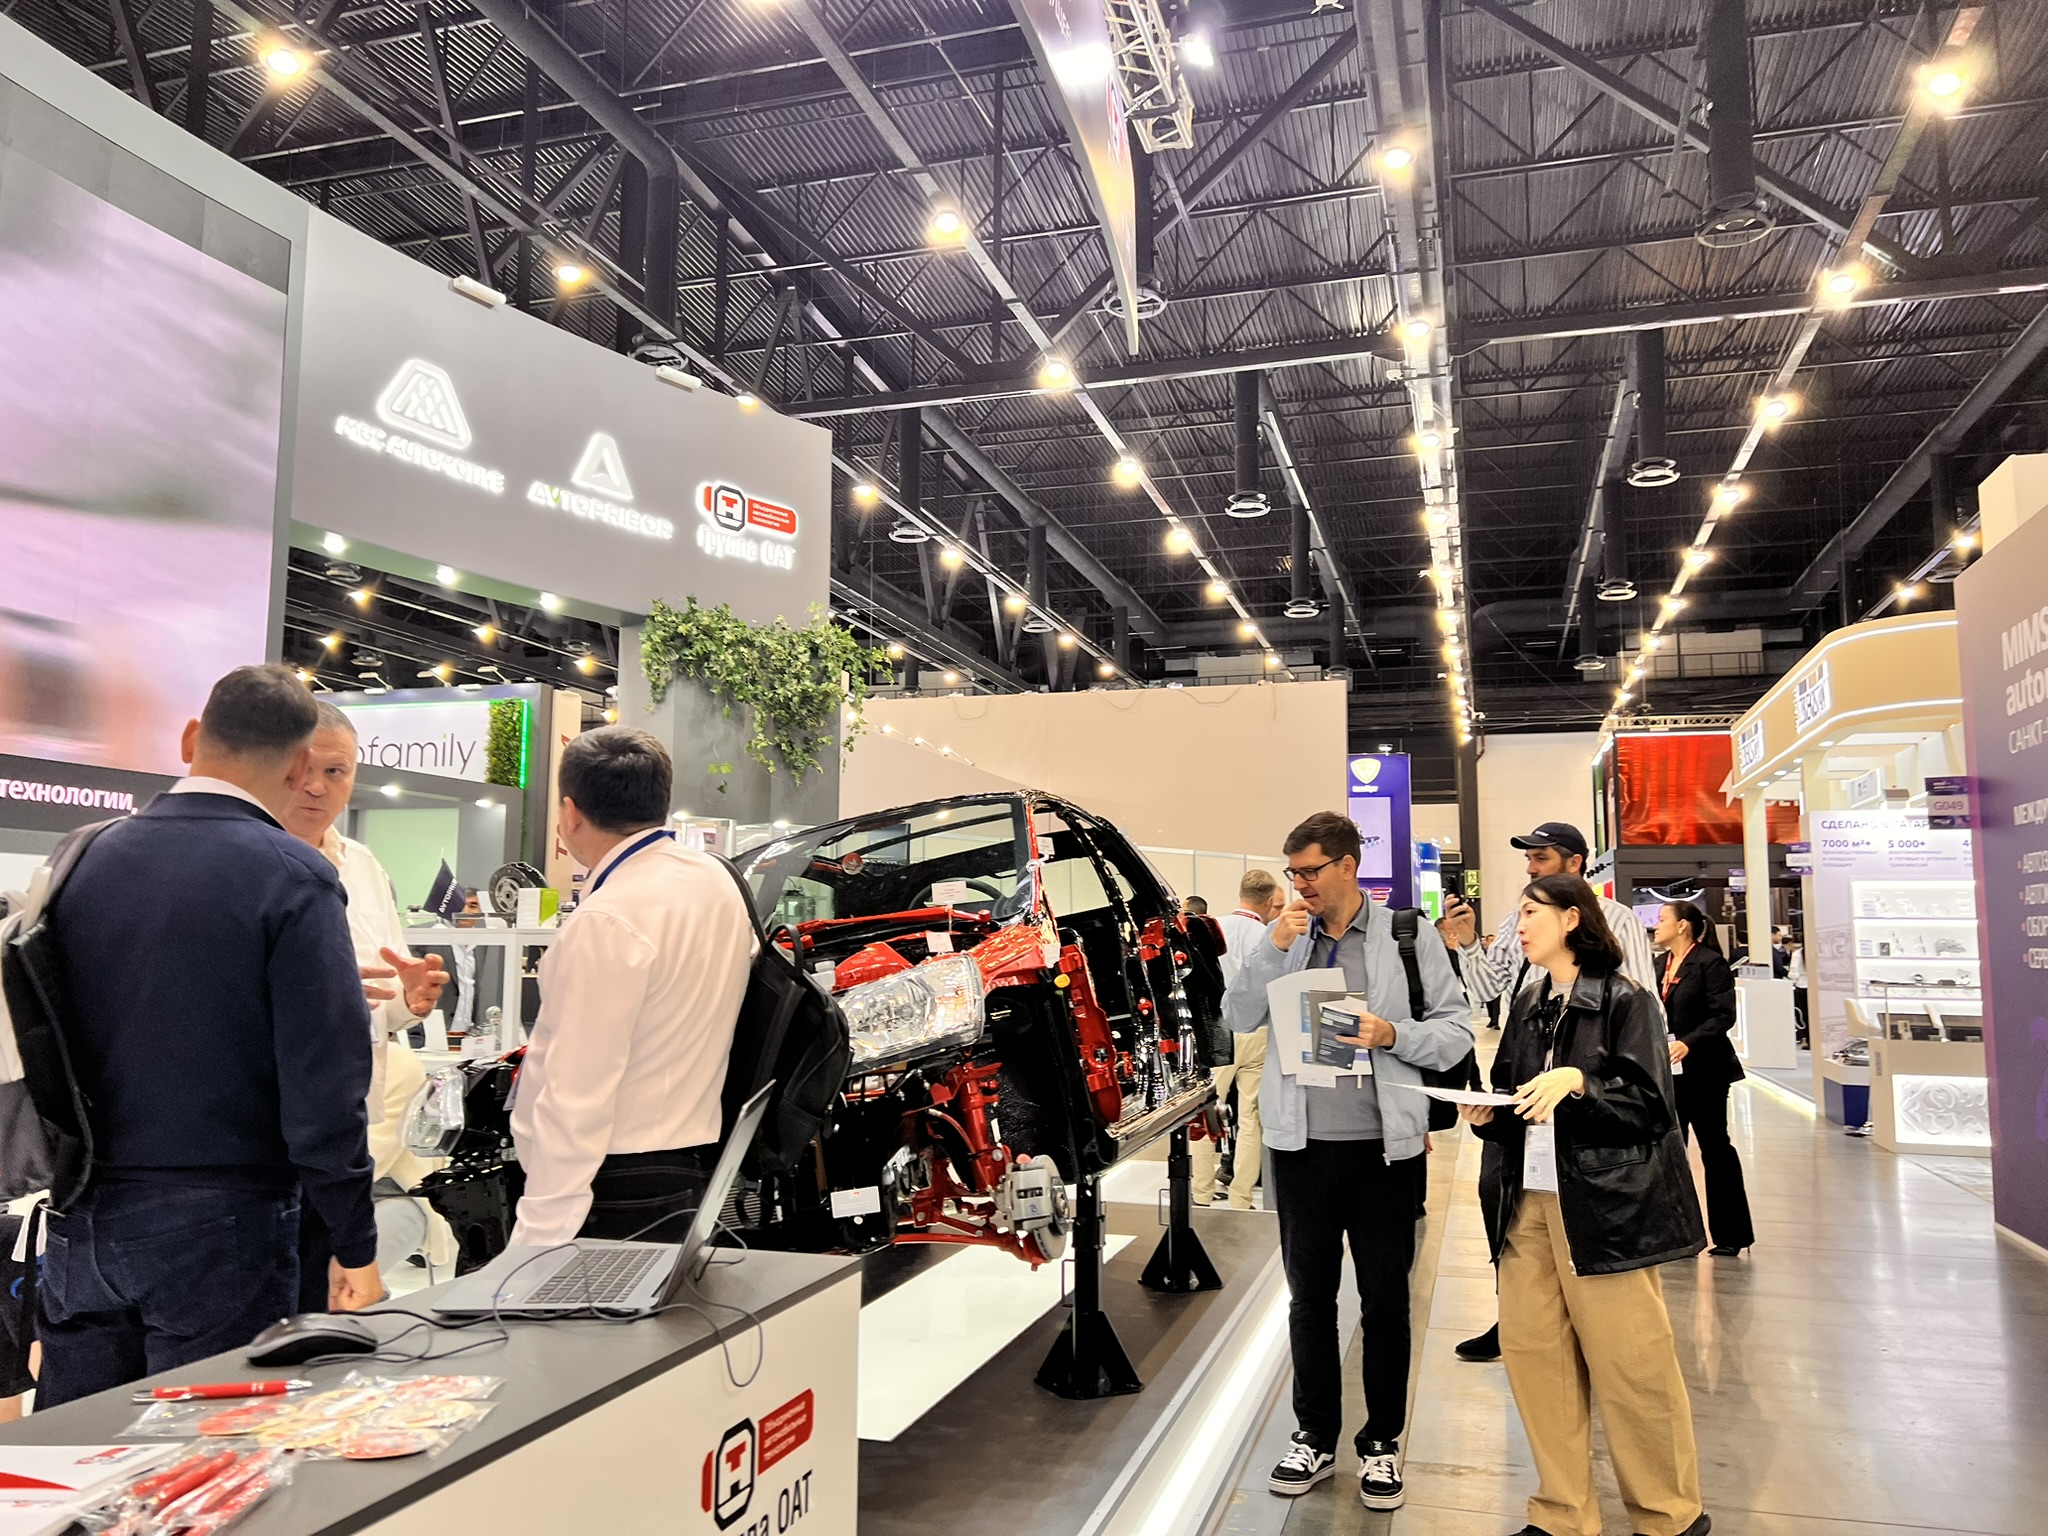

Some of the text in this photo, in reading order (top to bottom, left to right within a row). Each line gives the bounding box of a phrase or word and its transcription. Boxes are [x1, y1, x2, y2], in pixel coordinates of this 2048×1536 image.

[526, 480, 674, 540] AVTOPRIBOR
[696, 523, 758, 562] Группа
[2005, 667, 2048, 717] auto
[0, 778, 139, 816] технологии,
[1933, 800, 1964, 811] G049
[1822, 839, 1849, 848] 7000
[1888, 839, 1926, 848] 5 000+
[777, 1468, 813, 1536] ОАТ
